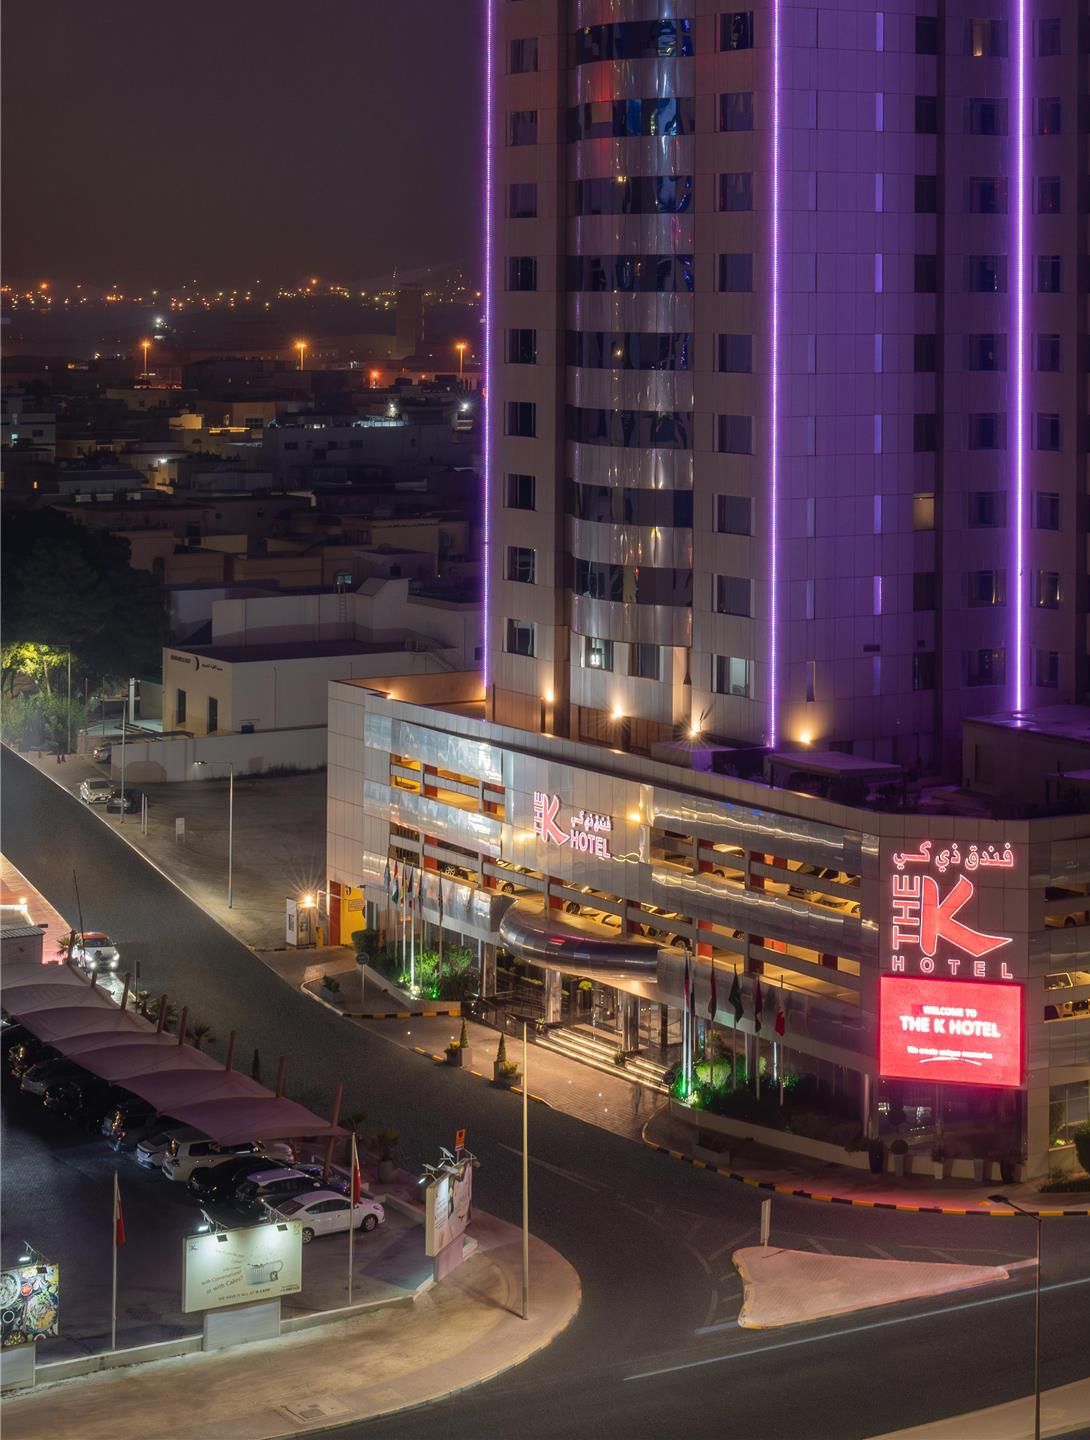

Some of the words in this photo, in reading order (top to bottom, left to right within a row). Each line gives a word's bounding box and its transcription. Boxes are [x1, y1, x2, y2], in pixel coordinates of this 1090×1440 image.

[534, 791, 544, 835] THE
[542, 793, 570, 846] K
[570, 829, 611, 859] HOTEL
[893, 840, 932, 870] كي
[935, 843, 961, 872] ذي
[965, 842, 1014, 870] فندق
[892, 874, 920, 950] THE
[919, 874, 1014, 957] K
[892, 955, 1013, 979] HOTEL
[922, 1005, 964, 1017] WELCOME
[965, 1008, 978, 1018] TO
[899, 1015, 931, 1033] THE
[933, 1018, 946, 1034] K
[948, 1018, 1001, 1038] HOTEL
